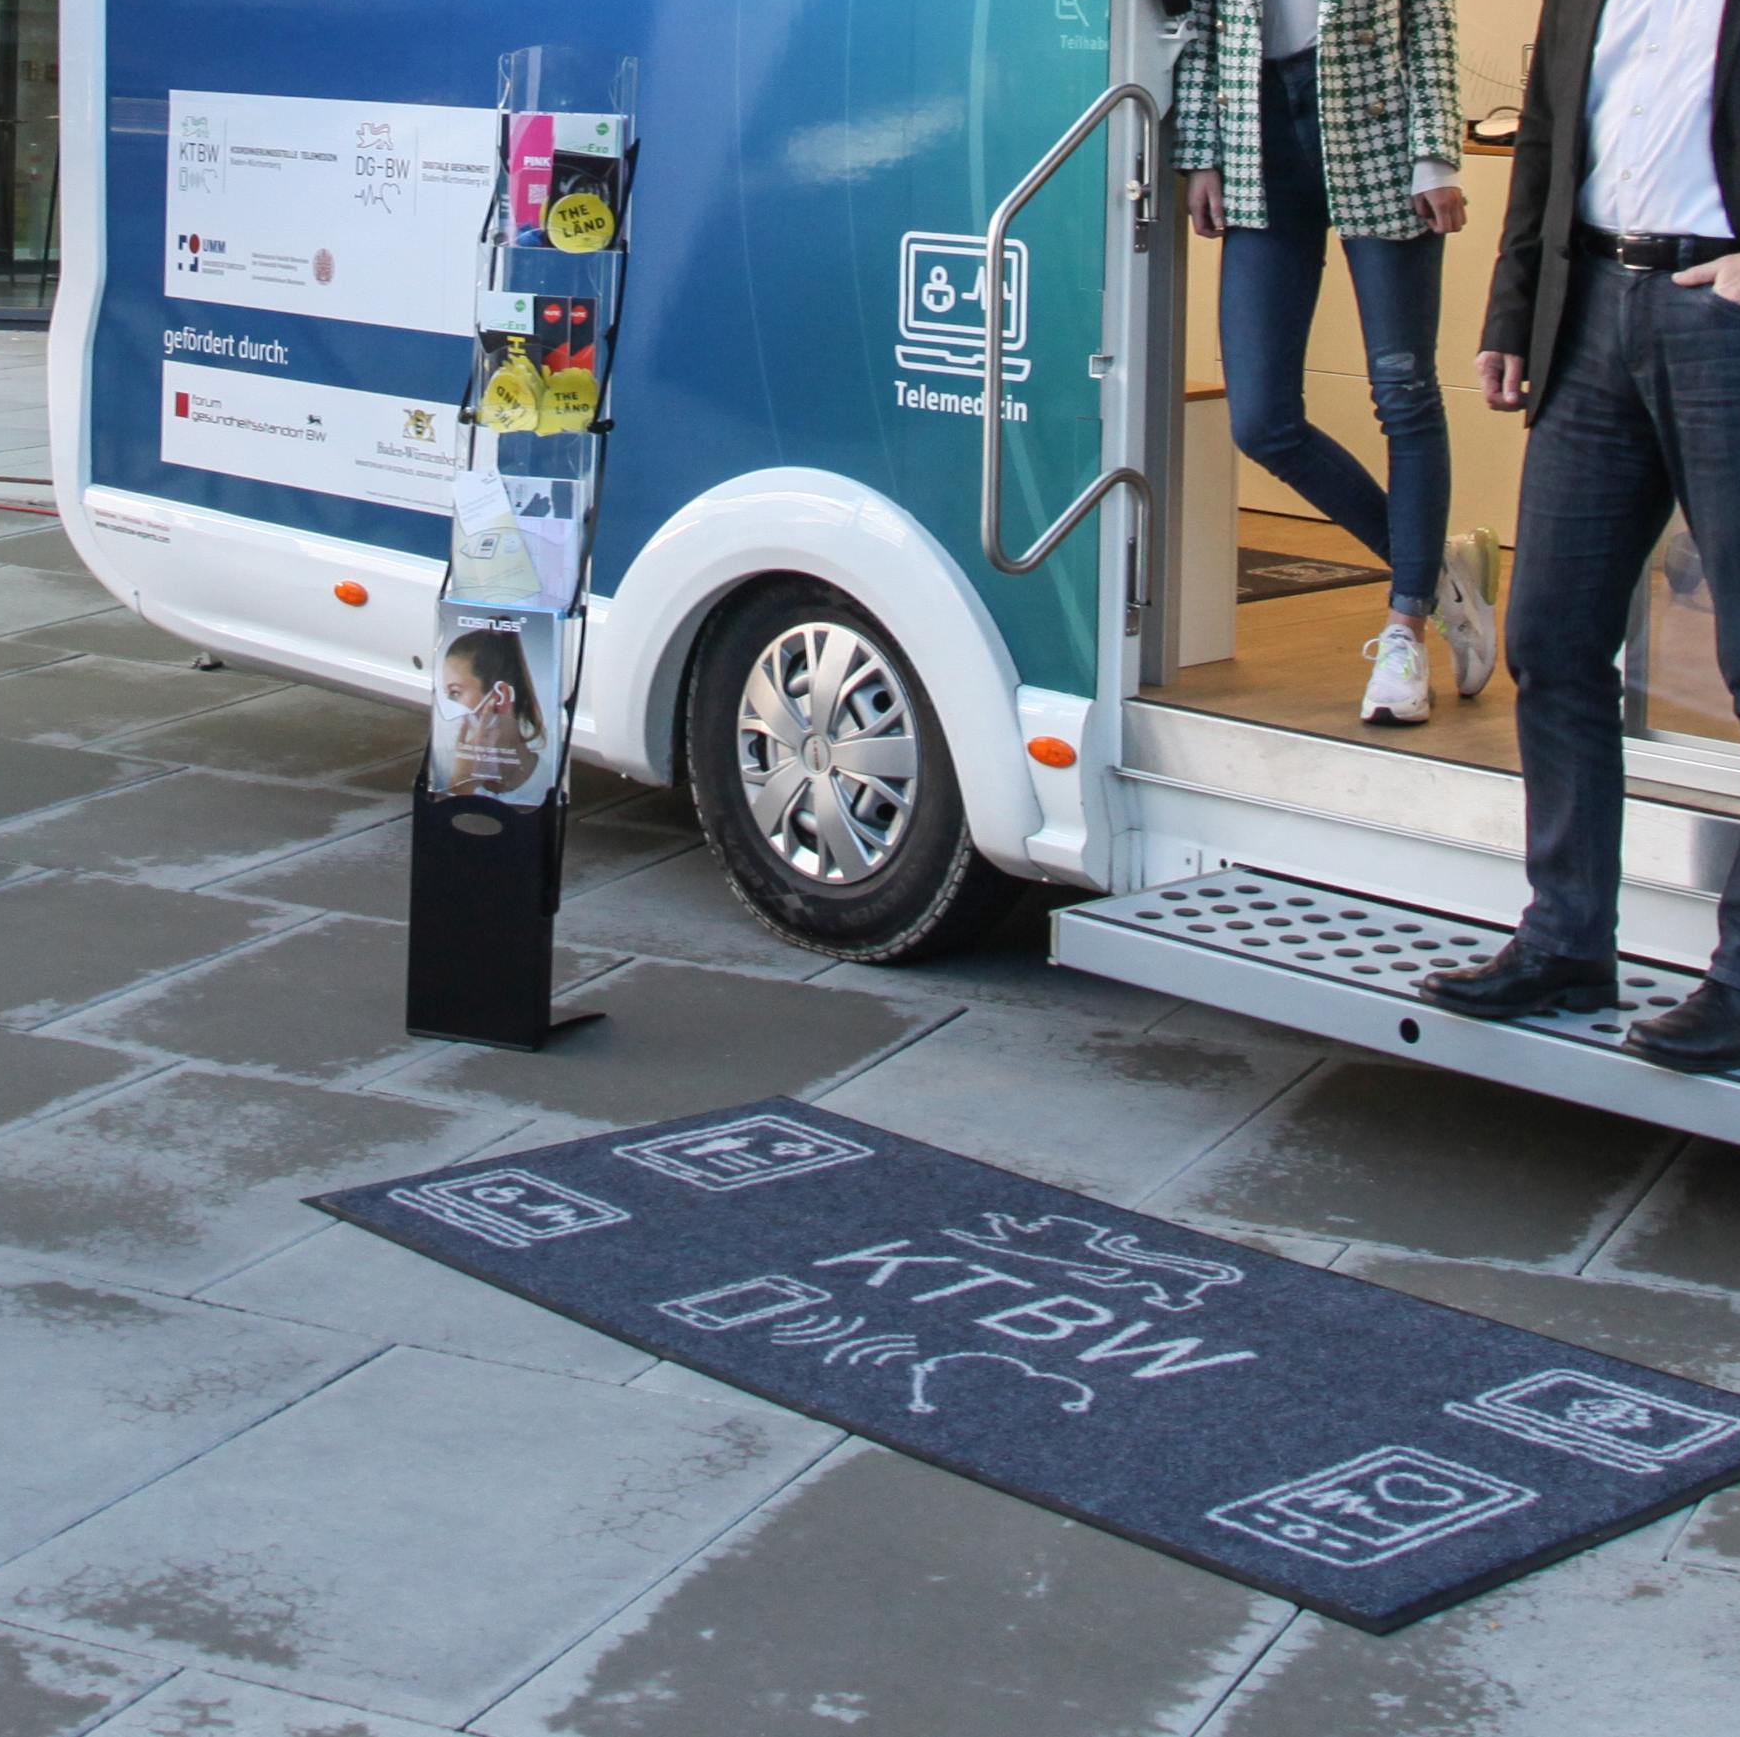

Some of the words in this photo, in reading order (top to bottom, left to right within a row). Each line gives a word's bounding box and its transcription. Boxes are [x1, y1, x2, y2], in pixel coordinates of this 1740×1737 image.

[1060, 33, 1109, 51] Teilhab
[178, 141, 220, 163] KTBW
[523, 155, 551, 168] PINK
[355, 155, 411, 180] DG-BW
[557, 203, 590, 222] THE
[562, 217, 606, 239] LÄND
[163, 326, 235, 357] gefördert
[238, 334, 290, 365] durch:
[191, 393, 223, 410] forum
[554, 391, 579, 401] THE
[894, 379, 1028, 423] Telemedin
[556, 402, 590, 415] LÄND
[191, 410, 304, 441] gesundheitsstandort
[305, 429, 328, 443] BW
[812, 1239, 1258, 1379] KTBW
